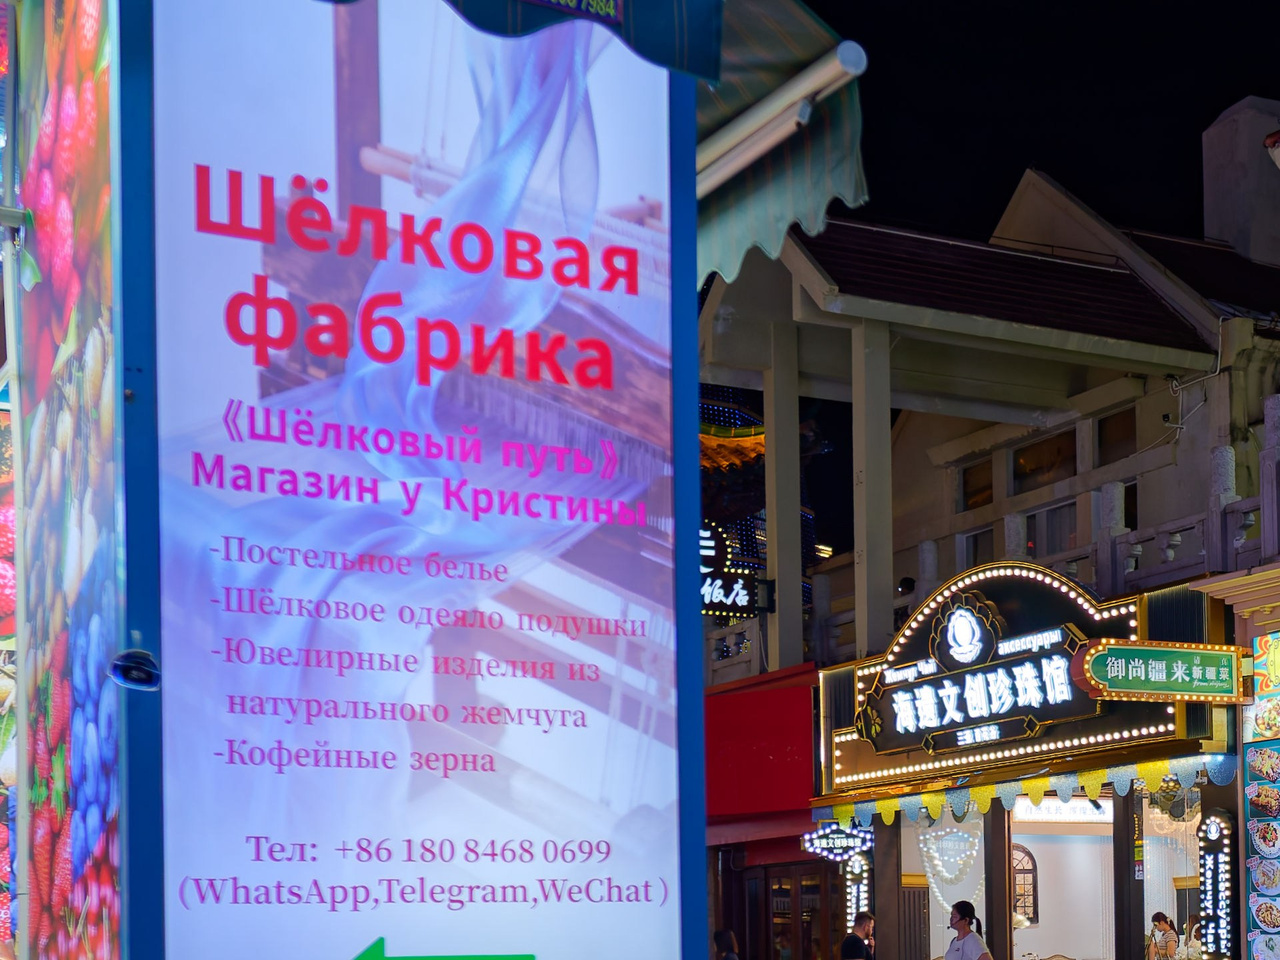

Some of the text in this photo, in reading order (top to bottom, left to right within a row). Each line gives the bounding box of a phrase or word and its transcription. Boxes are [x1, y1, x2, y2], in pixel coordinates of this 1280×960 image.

[193, 163, 641, 297] Шёлковая
[224, 272, 614, 391] фабрика
[191, 451, 649, 528] Магазин у Кристины
[209, 535, 509, 583] -Постельное белье
[210, 586, 648, 641] -Шёлковое одеяло подушки
[211, 637, 600, 683] -Ювелирные изделия из
[1105, 656, 1191, 683] 御尚疆来
[1191, 666, 1230, 681] 新疆菜
[227, 694, 588, 733] натурального жемчуга
[213, 739, 496, 779] -Кофейные зерна
[246, 836, 611, 864] Тел: +86 180 8468 0699
